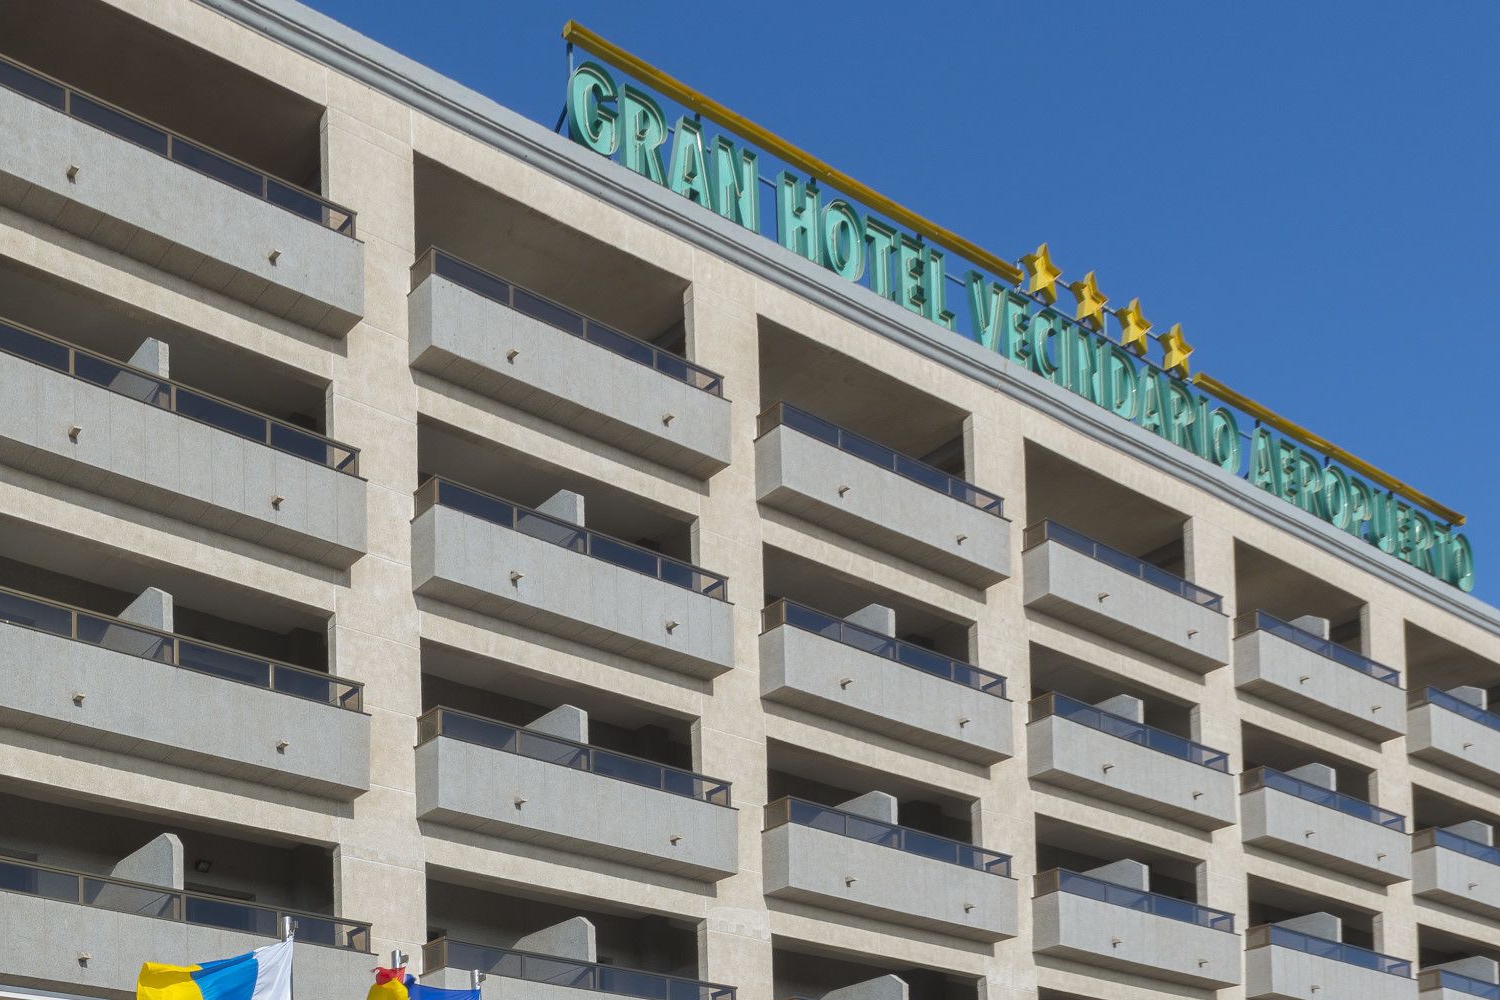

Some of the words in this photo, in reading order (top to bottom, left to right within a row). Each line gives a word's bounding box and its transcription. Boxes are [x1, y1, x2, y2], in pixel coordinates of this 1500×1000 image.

[567, 61, 760, 235] GRAN
[776, 170, 957, 332] HOTEL
[964, 269, 1242, 475] VECINDARIO
[1248, 427, 1475, 593] AEROPUERTO
